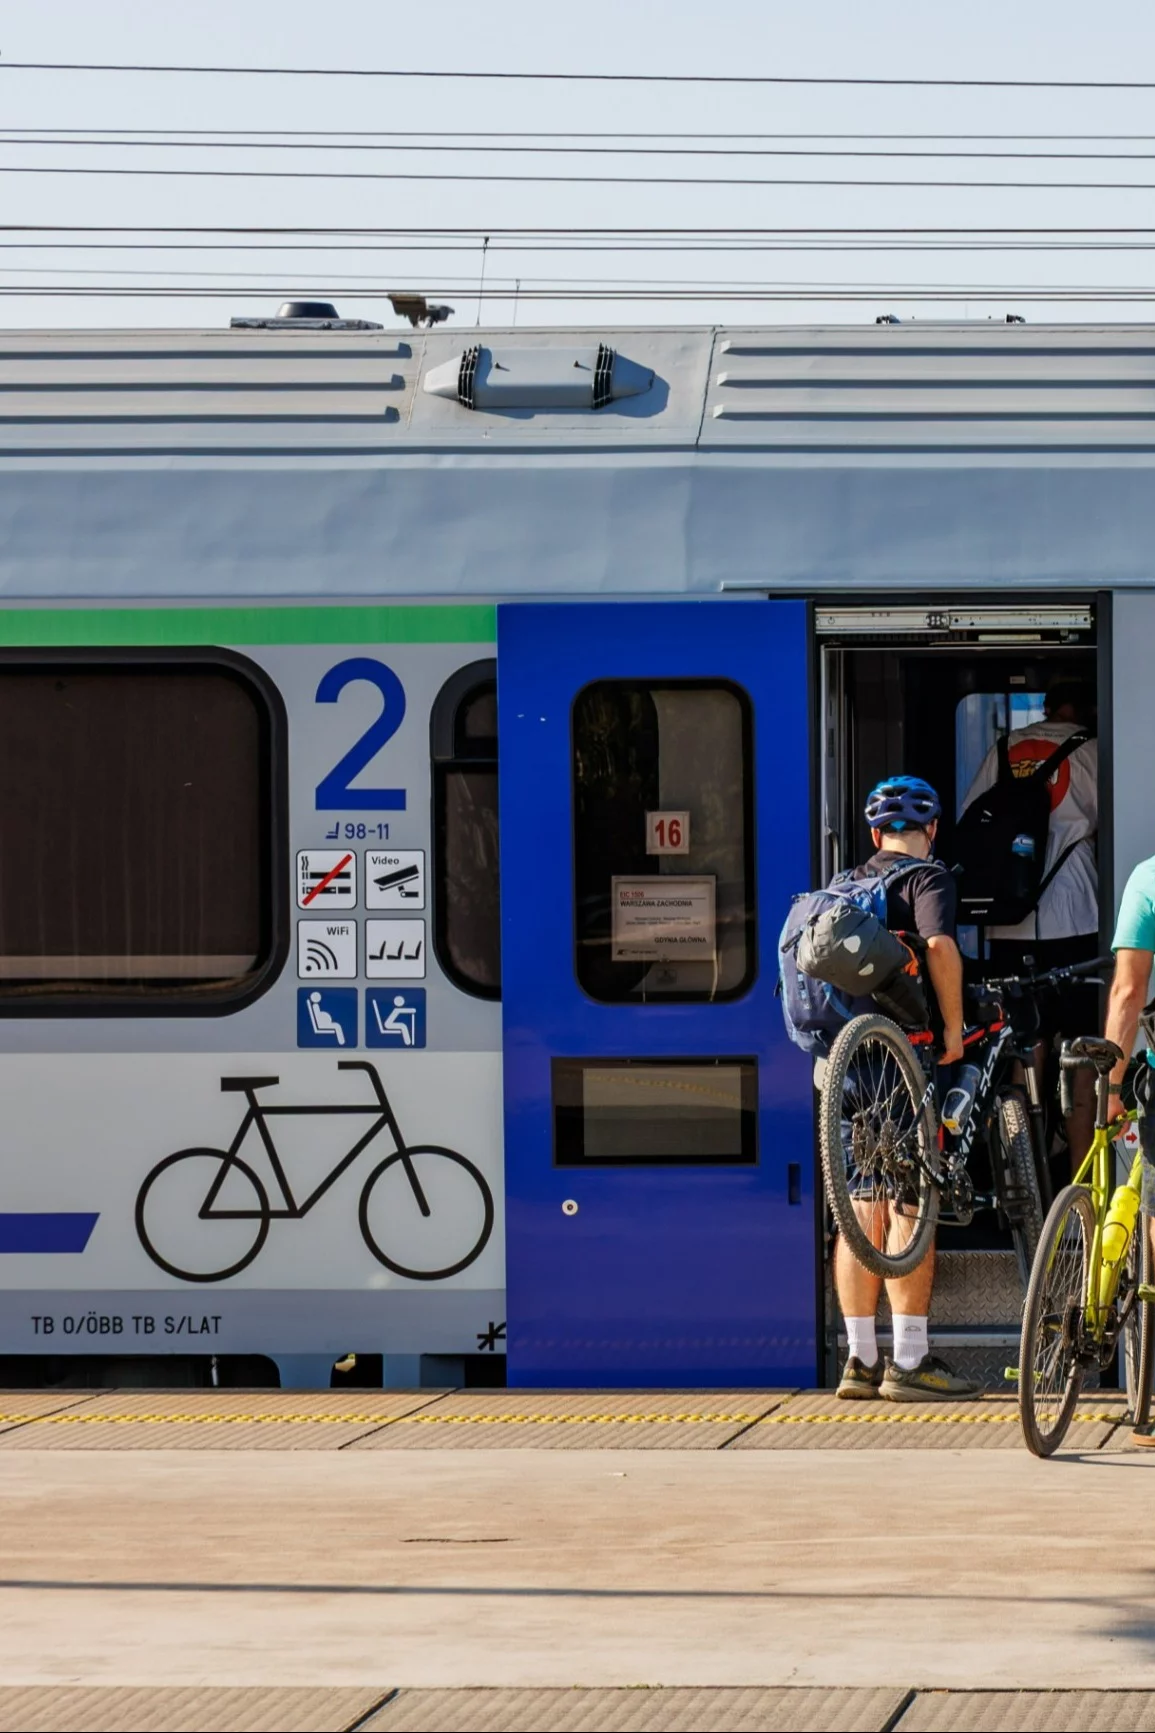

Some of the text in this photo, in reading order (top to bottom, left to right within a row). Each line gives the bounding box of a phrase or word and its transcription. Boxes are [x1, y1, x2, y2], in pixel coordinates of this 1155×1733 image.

[315, 657, 407, 811] 2
[344, 822, 390, 840] 98-11
[655, 819, 682, 848] 16
[371, 855, 400, 867] Video
[326, 925, 349, 937] WiFi
[32, 1317, 55, 1334] TB
[132, 1317, 156, 1334] TB
[164, 1316, 222, 1335] S/LAT
